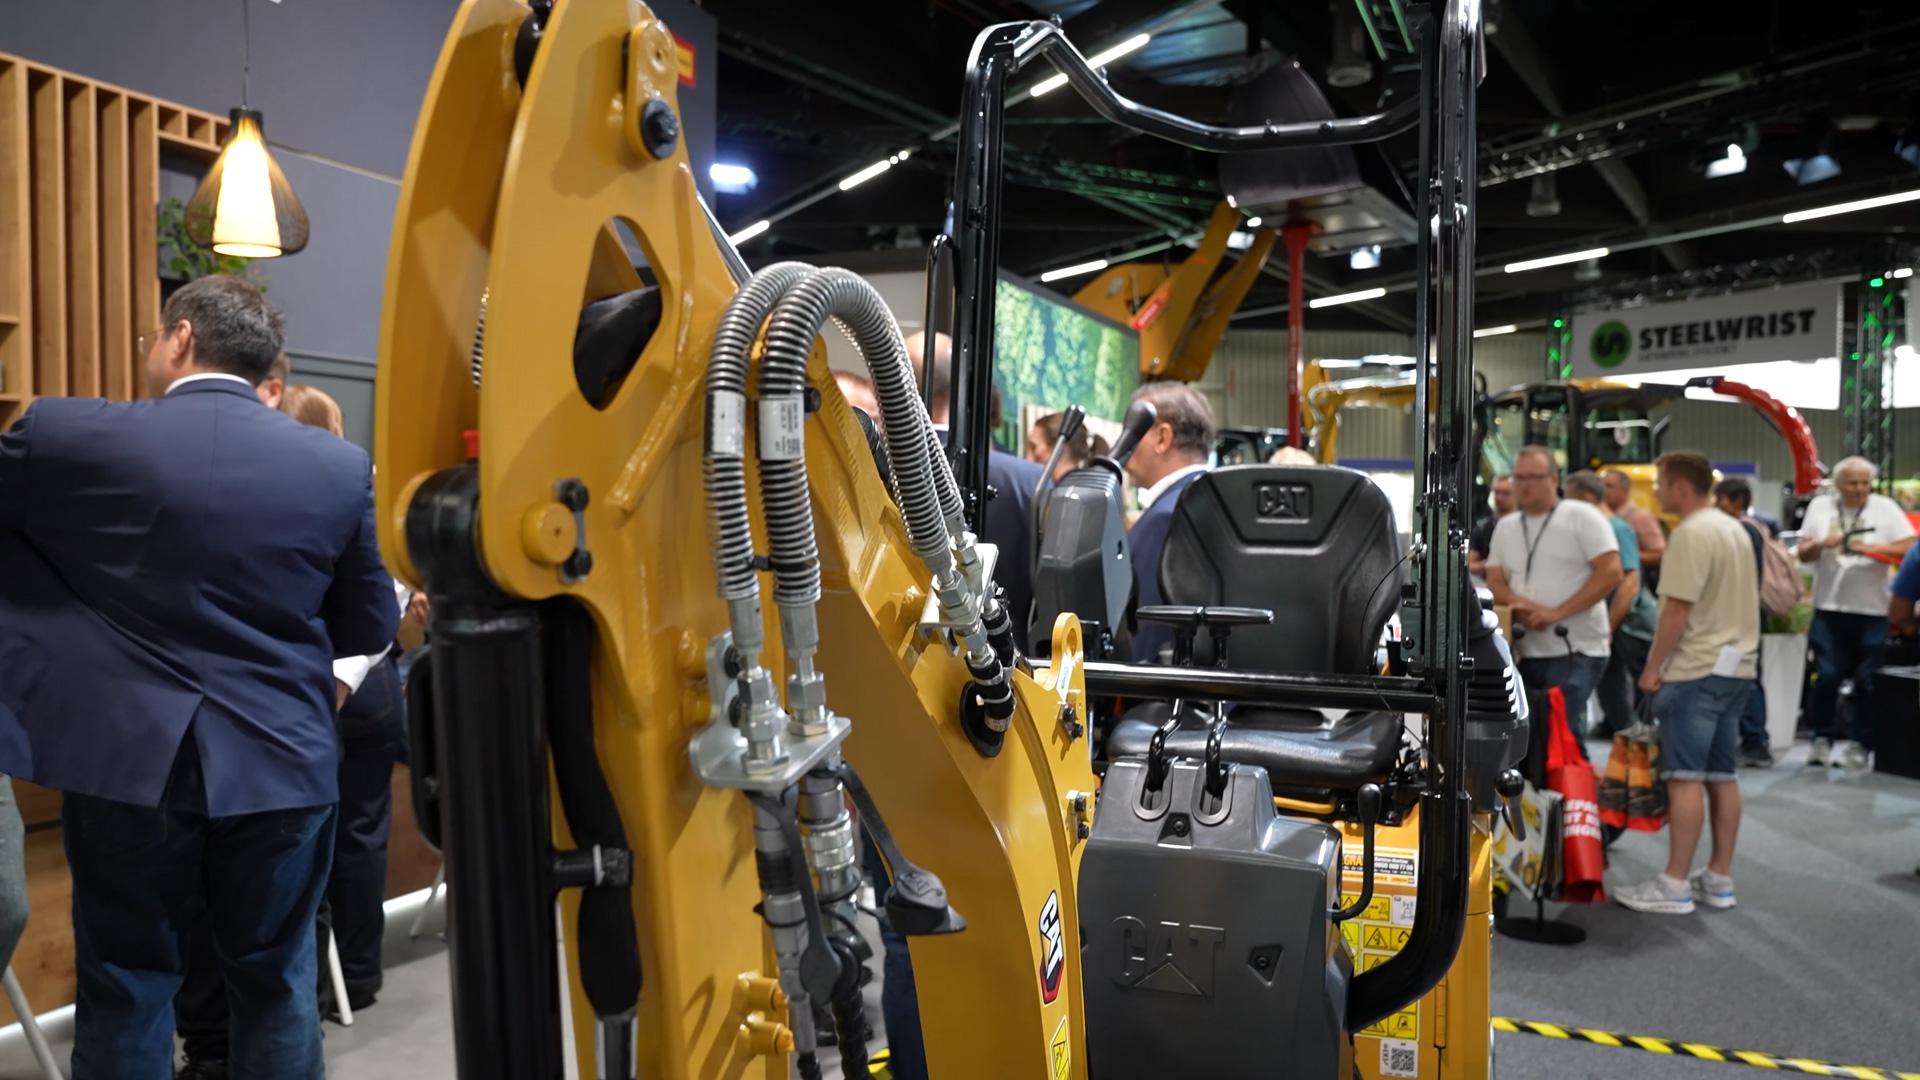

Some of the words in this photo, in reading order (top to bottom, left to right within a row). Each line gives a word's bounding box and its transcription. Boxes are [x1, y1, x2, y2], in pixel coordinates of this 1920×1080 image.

[1638, 309, 1816, 350] STEELWRIST
[1258, 486, 1307, 517] CAT
[1040, 891, 1064, 979] CAT
[1111, 915, 1225, 998] CAT
